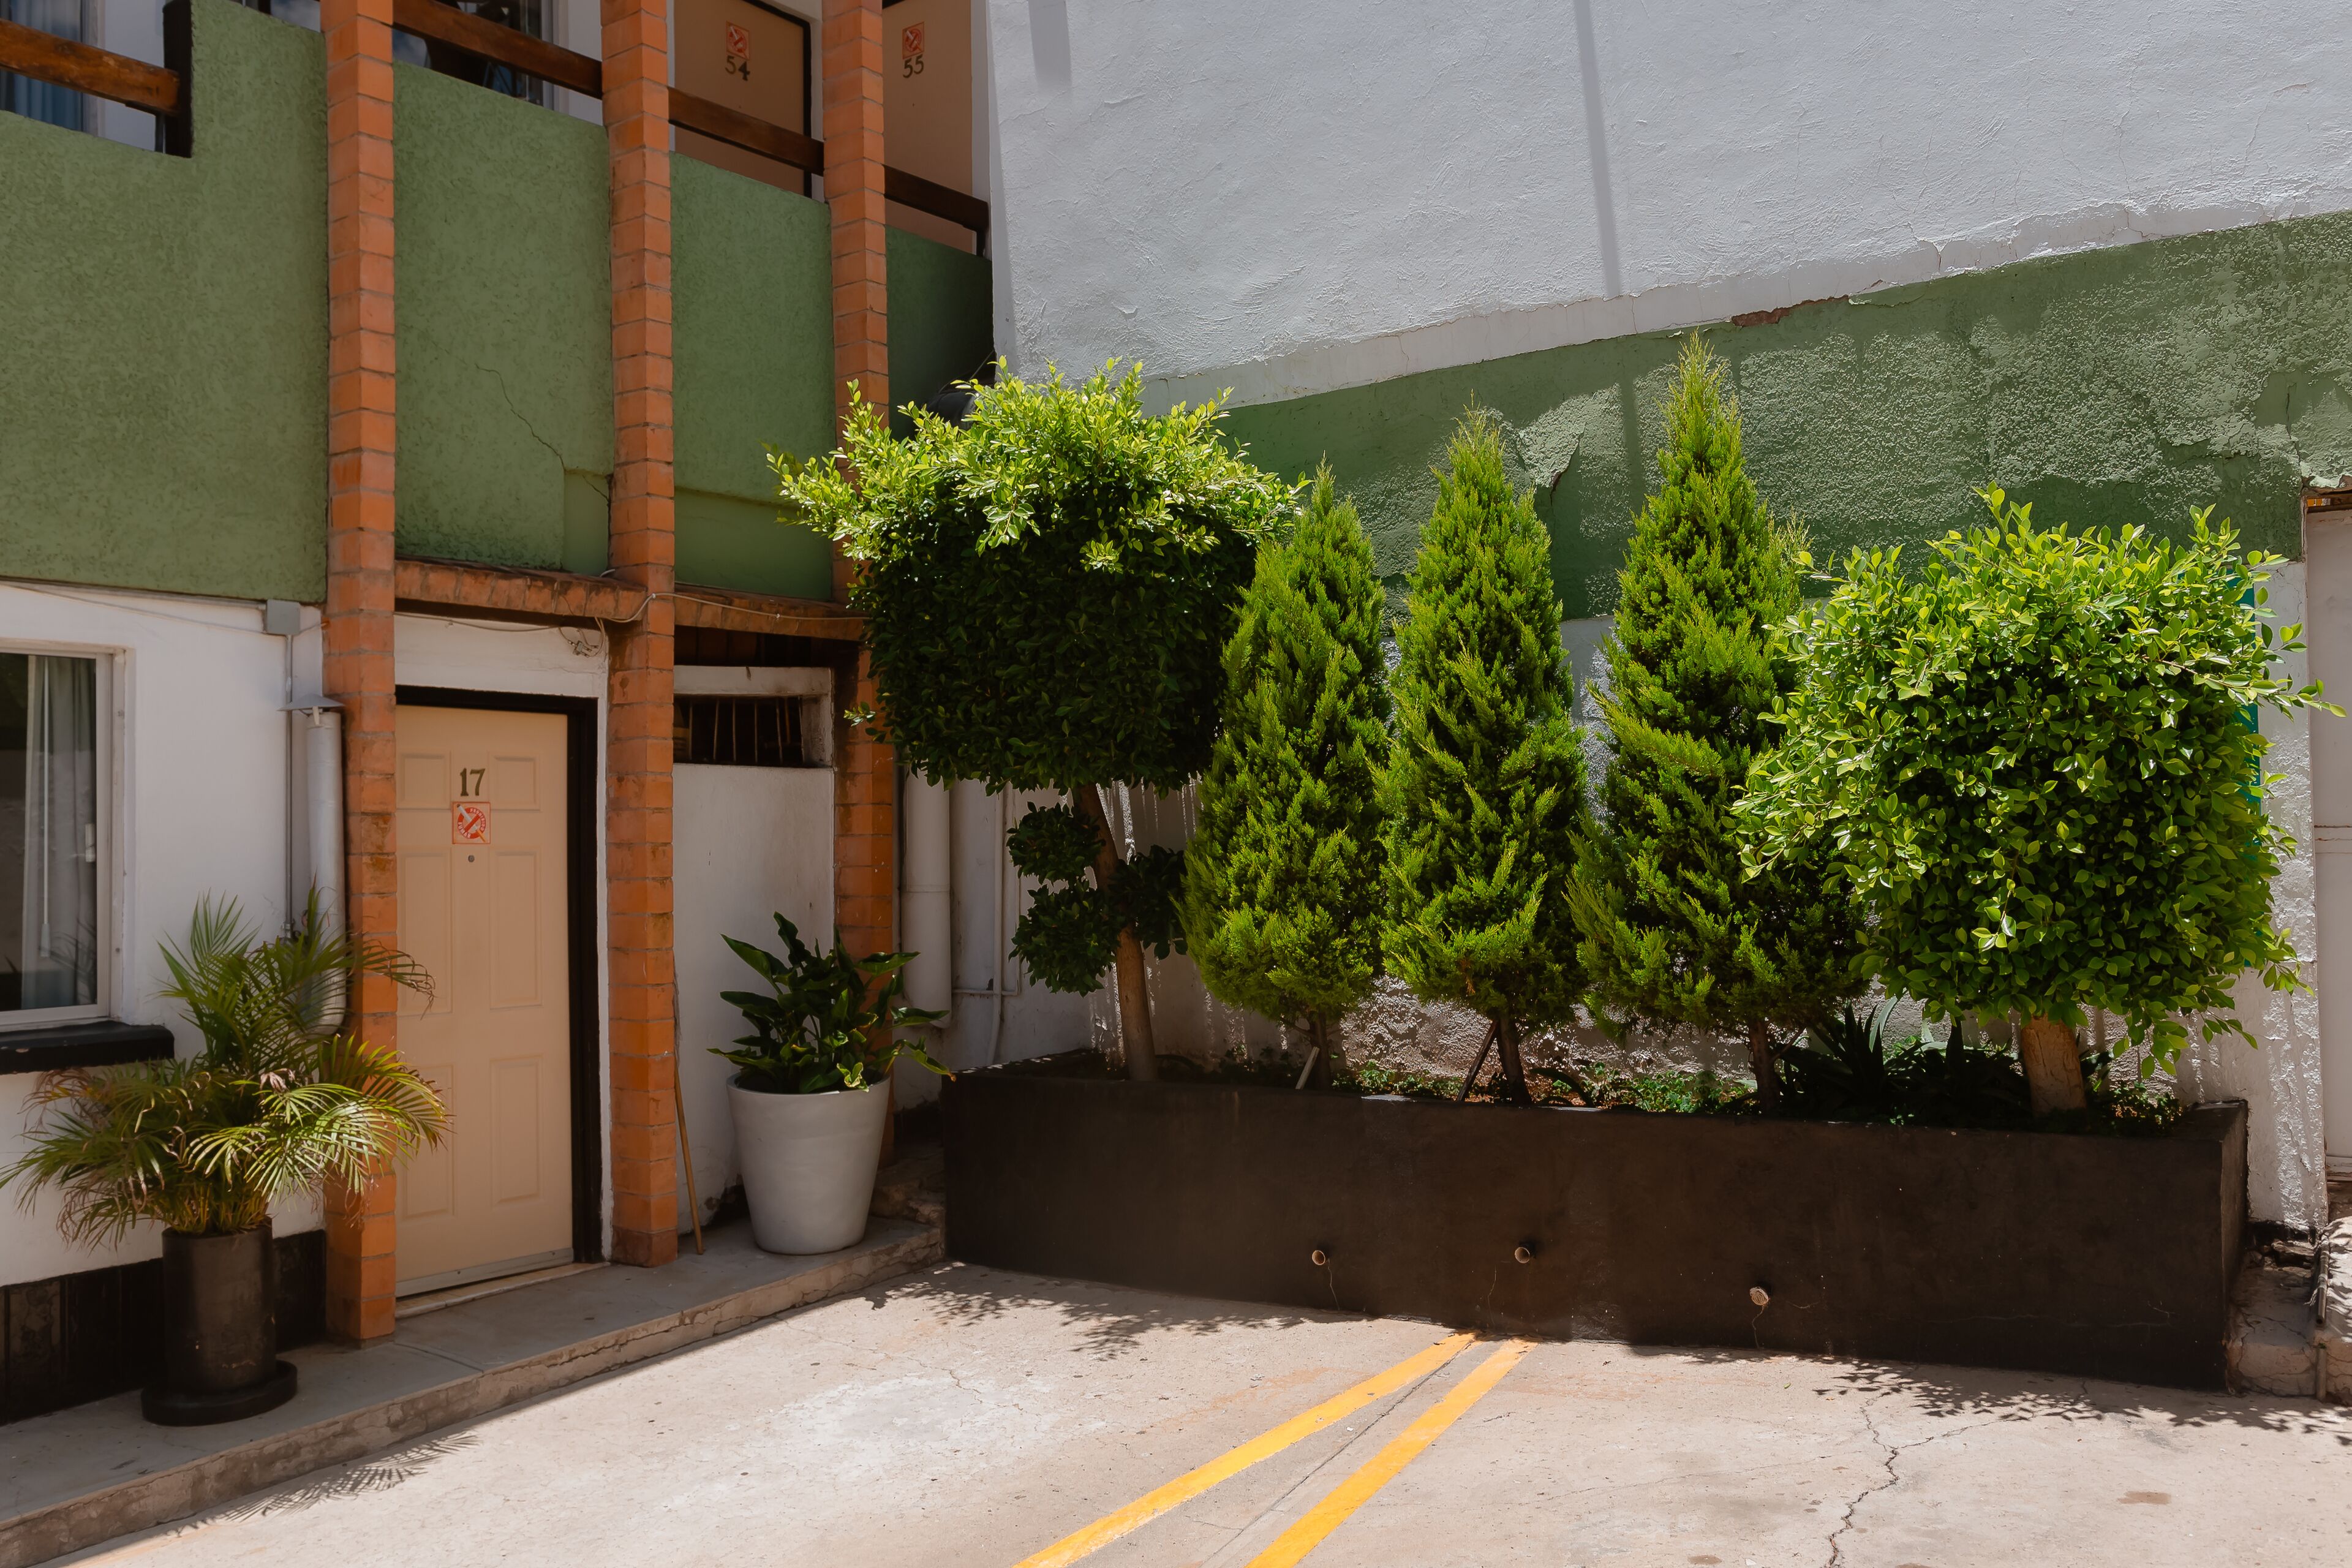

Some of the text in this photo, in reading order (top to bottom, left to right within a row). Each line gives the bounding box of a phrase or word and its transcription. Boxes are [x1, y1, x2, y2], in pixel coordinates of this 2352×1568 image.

[725, 55, 750, 81] 54
[903, 54, 924, 78] 55
[460, 767, 485, 796] 17
